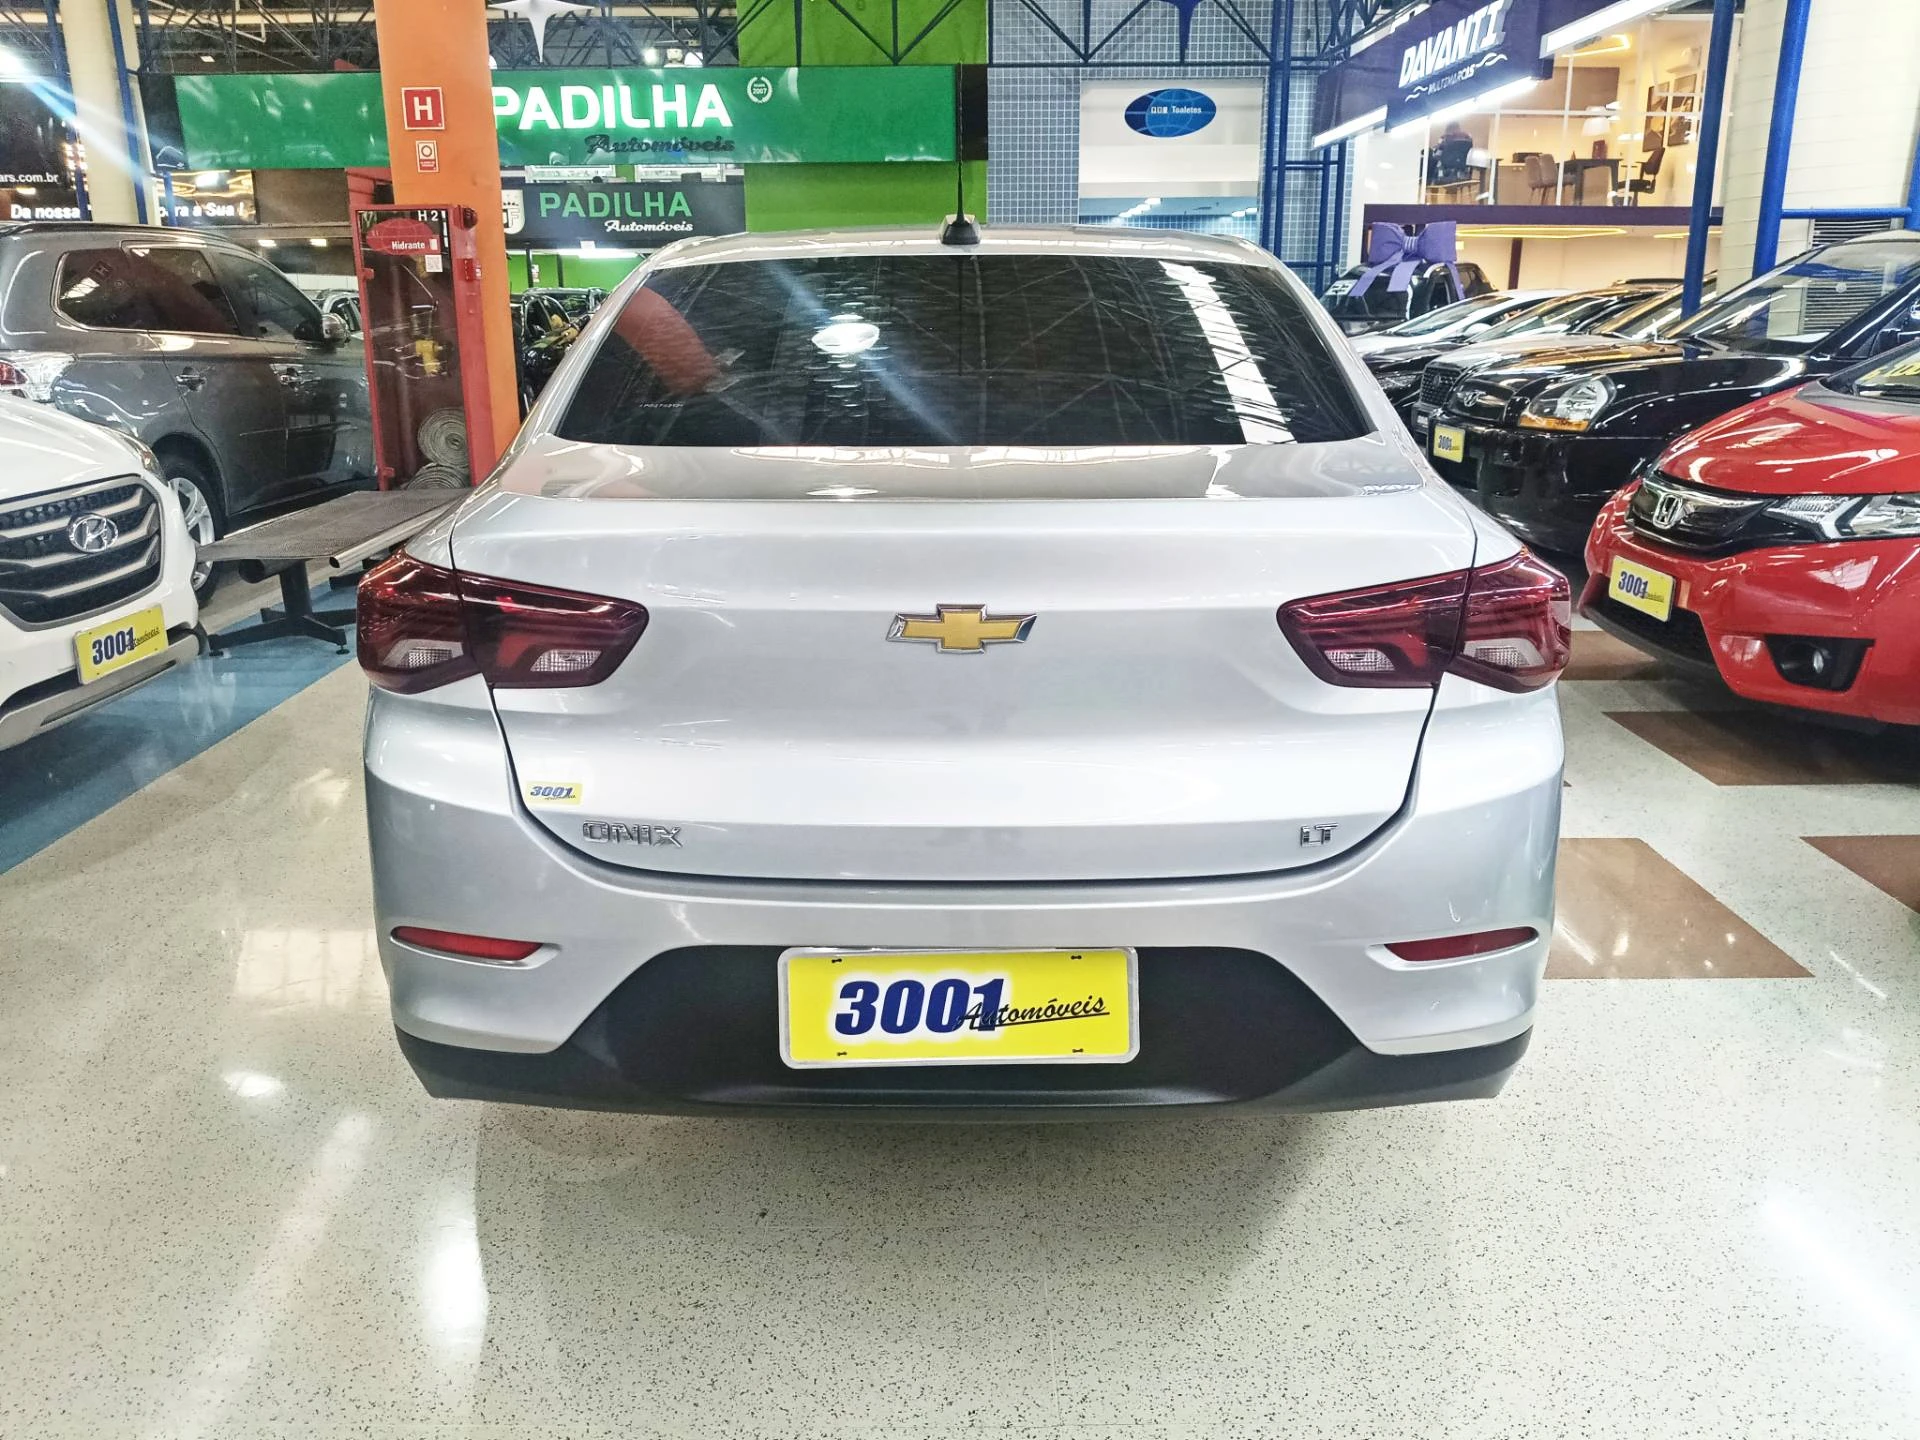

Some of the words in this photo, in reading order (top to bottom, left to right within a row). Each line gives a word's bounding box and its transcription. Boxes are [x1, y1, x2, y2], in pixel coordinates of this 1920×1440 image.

[1398, 0, 1506, 88] DAVANTI
[752, 87, 768, 95] 2007
[413, 96, 434, 121] H
[491, 84, 734, 130] PADILHA
[10, 204, 32, 219] Da
[35, 207, 81, 219] nossa
[205, 202, 235, 217] Sua
[418, 210, 427, 222] H
[430, 210, 439, 221] 2
[539, 191, 693, 218] PADILHA
[604, 219, 694, 233] Automóveis
[391, 240, 426, 251] Hidrante
[1618, 570, 1649, 599] 3001
[92, 626, 134, 666] 3001
[530, 785, 574, 798] 3001
[583, 819, 683, 849] ONIX
[1300, 823, 1339, 848] LT
[835, 977, 1005, 1036] 3001
[950, 994, 1111, 1032] Automóveis
